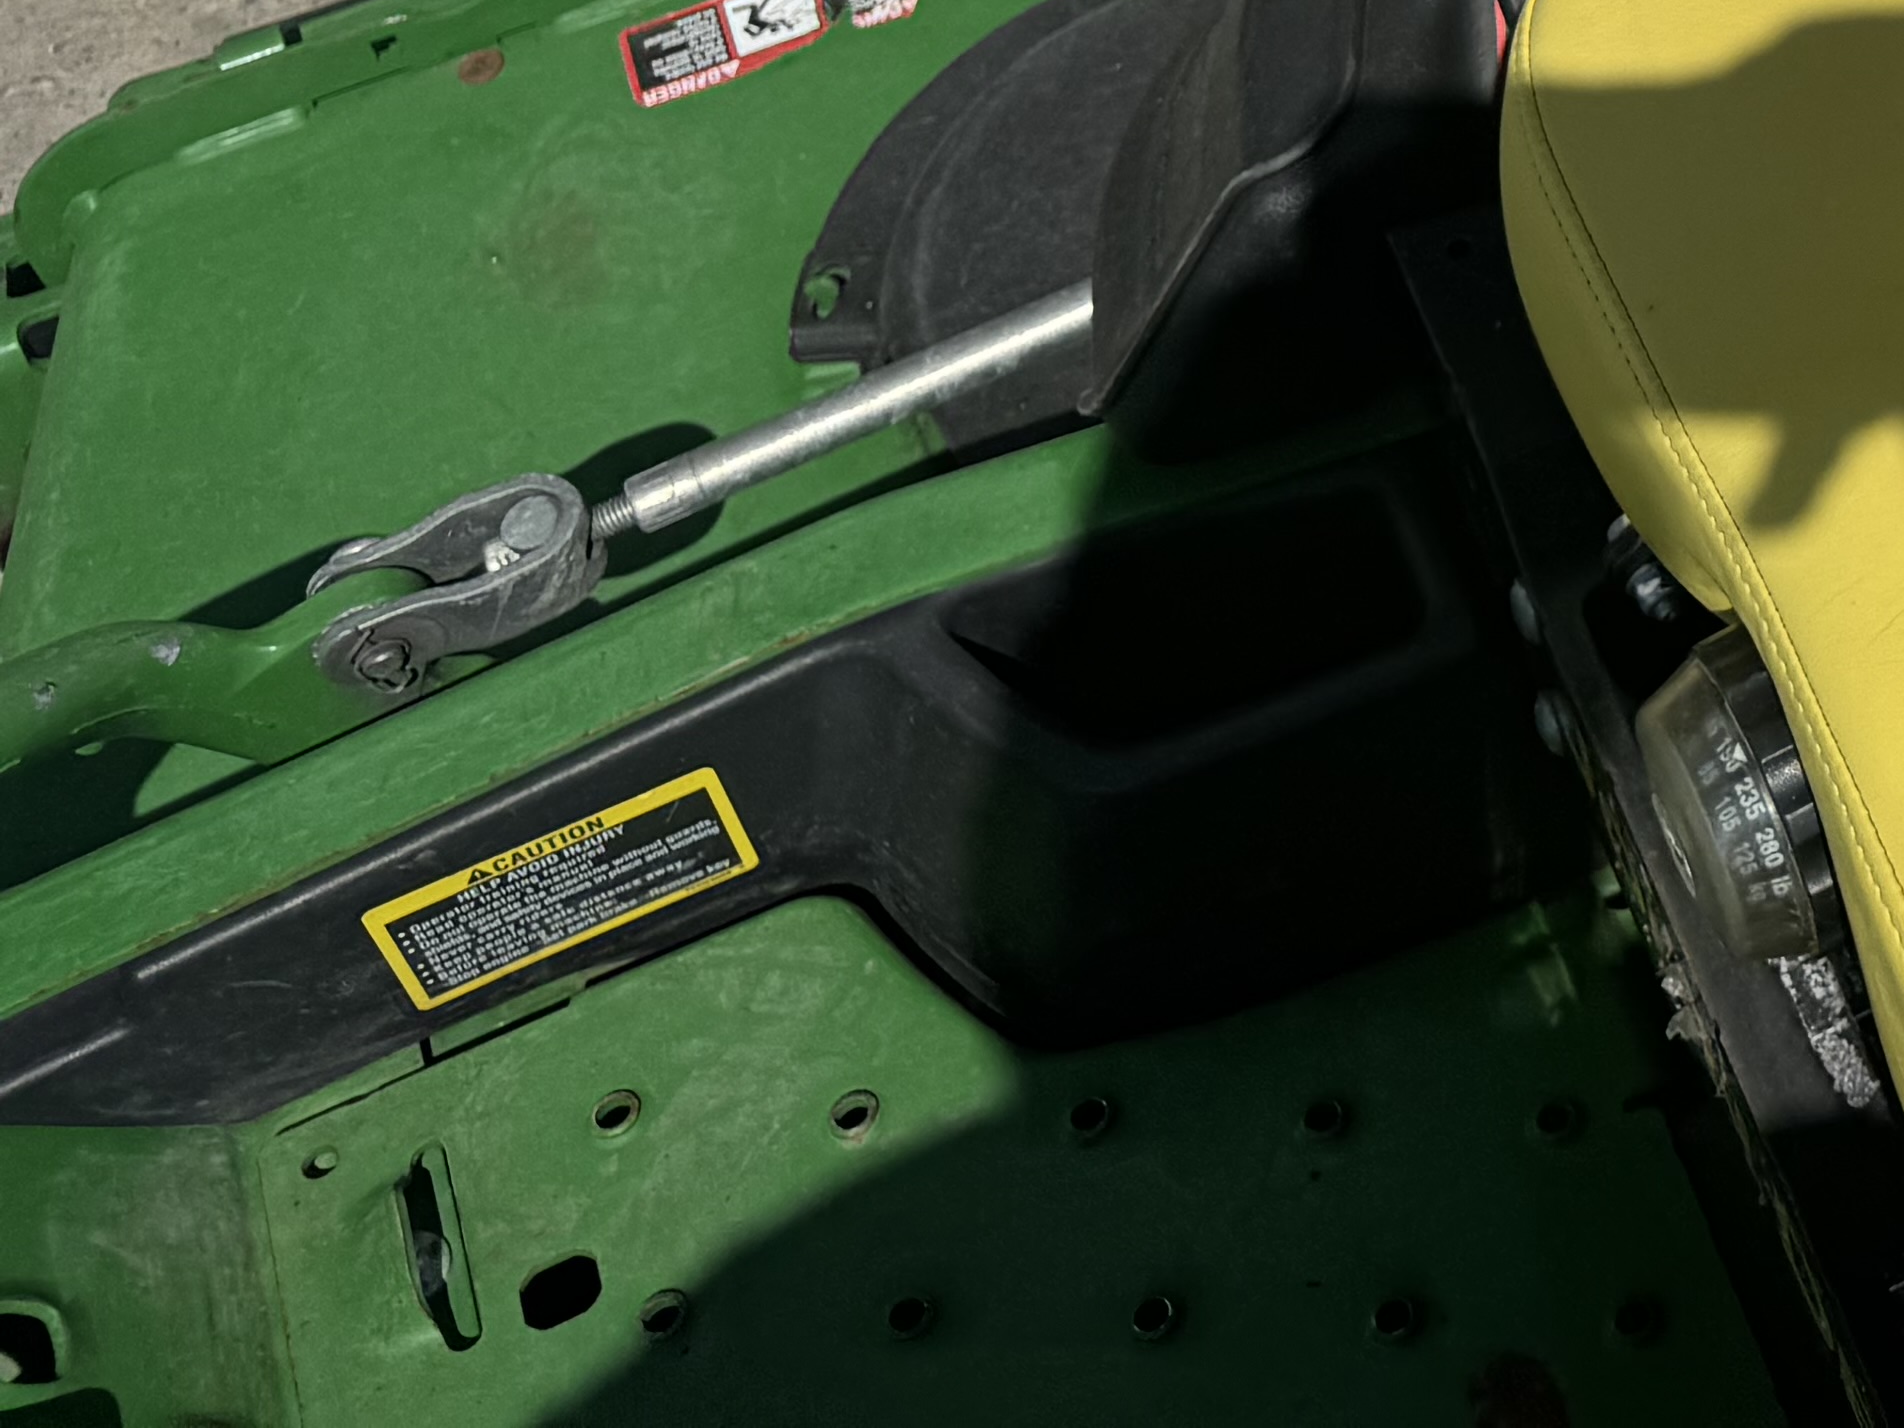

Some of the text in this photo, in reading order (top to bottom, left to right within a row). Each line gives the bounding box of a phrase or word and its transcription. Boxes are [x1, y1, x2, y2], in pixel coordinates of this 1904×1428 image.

[642, 68, 722, 108] DANGER
[1714, 796, 1742, 832] 105
[1733, 776, 1766, 821] 235
[1755, 827, 1785, 869] 280
[1770, 874, 1793, 897] lb
[457, 824, 623, 903] HELP AVOID INJURY
[493, 817, 604, 872] CAUTION
[409, 901, 475, 934] Operator
